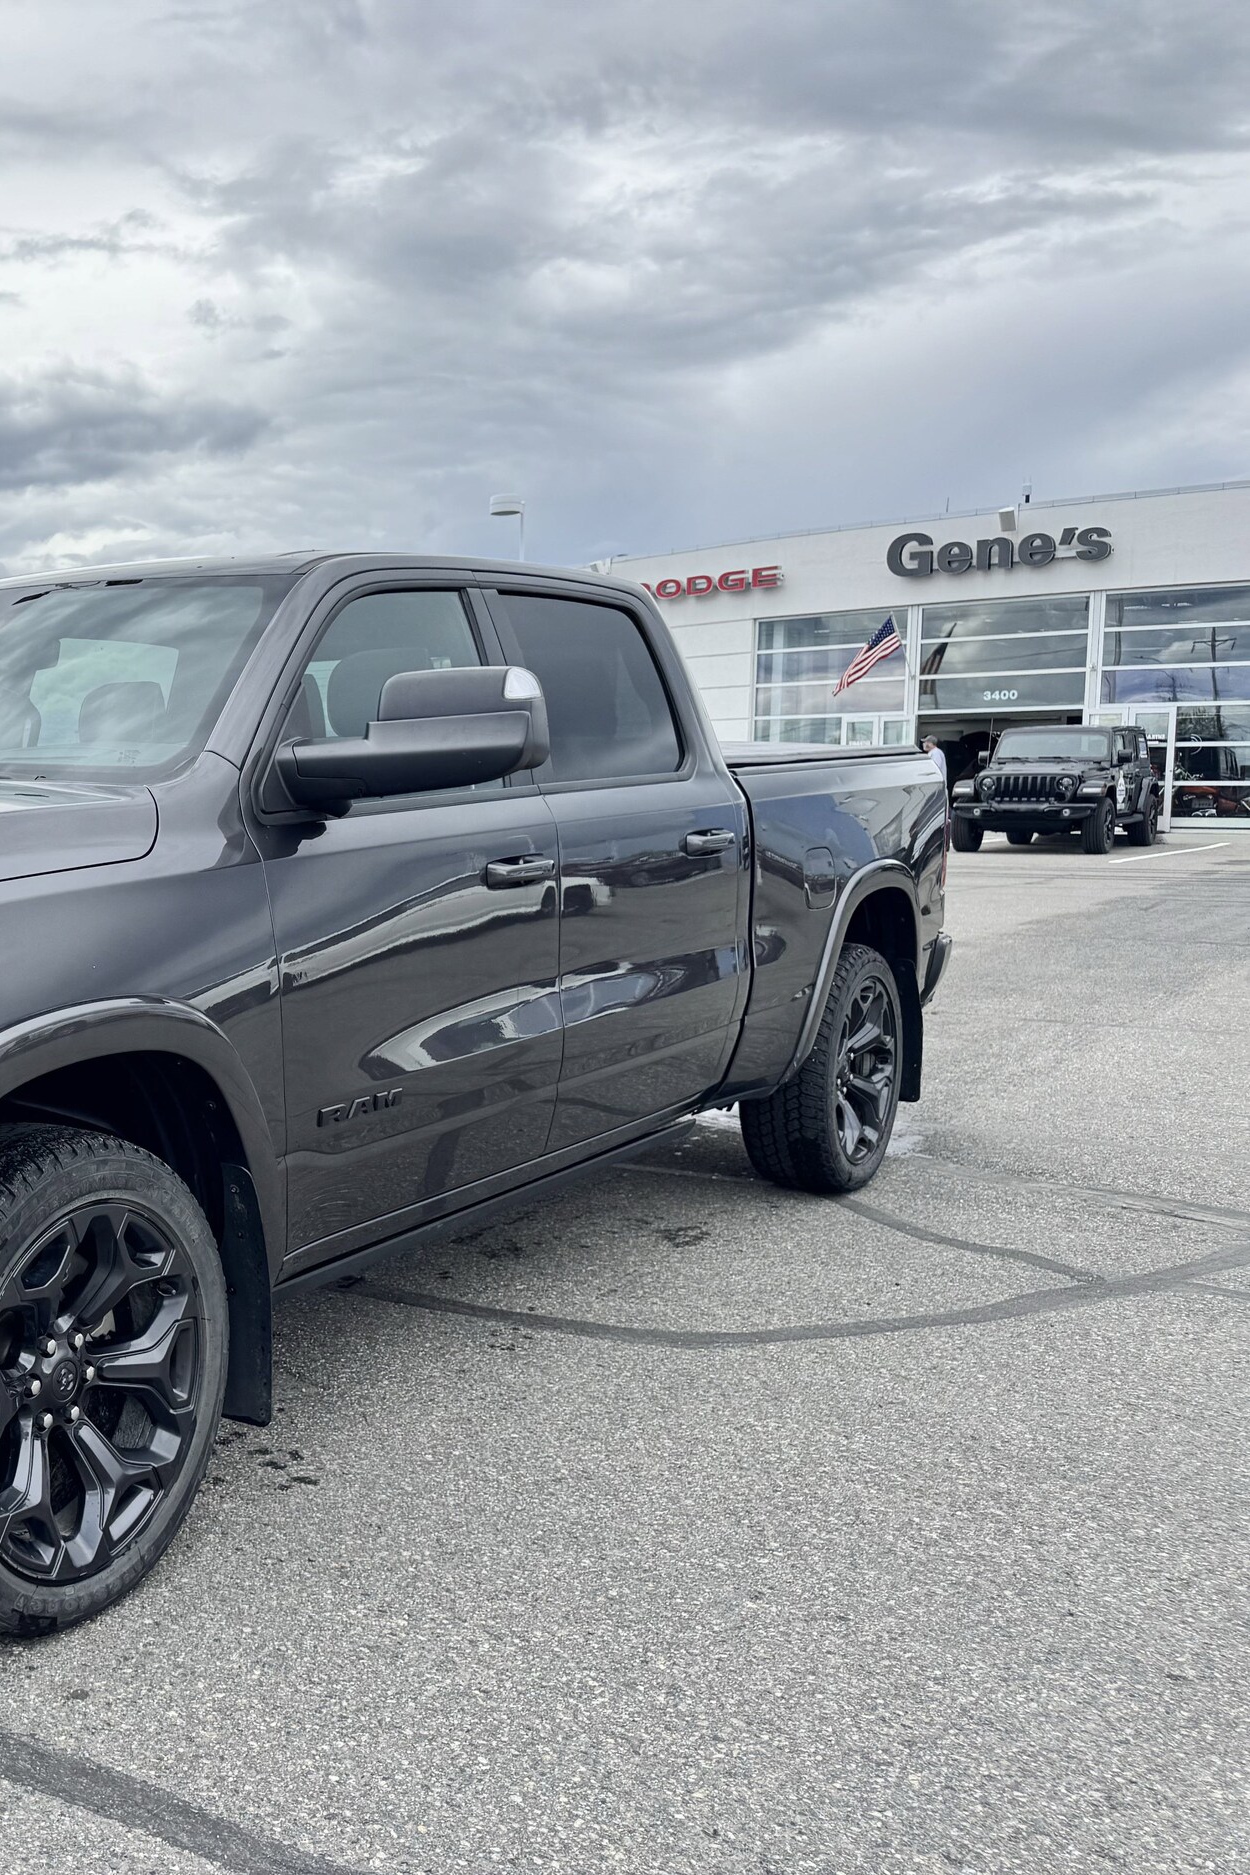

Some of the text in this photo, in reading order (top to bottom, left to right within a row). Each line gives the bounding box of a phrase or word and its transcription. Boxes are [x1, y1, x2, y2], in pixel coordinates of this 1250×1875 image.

[887, 527, 1112, 577] Gene's
[983, 690, 1018, 701] 3400
[316, 1087, 403, 1128] RAM
